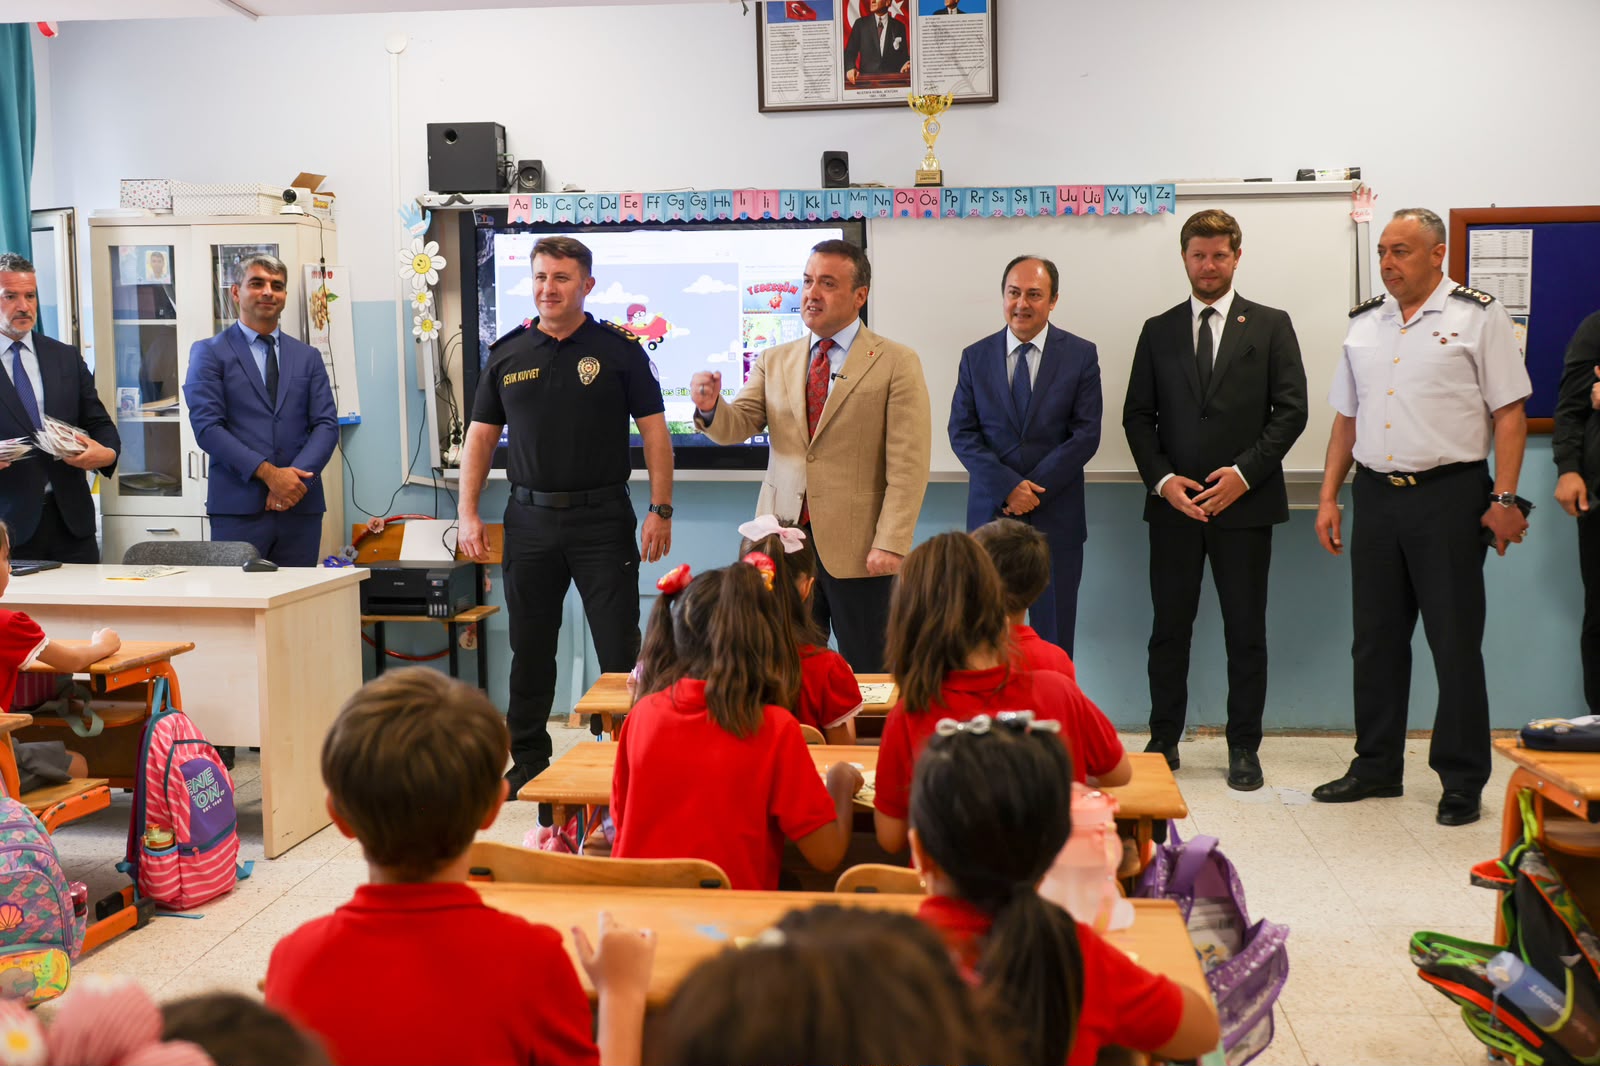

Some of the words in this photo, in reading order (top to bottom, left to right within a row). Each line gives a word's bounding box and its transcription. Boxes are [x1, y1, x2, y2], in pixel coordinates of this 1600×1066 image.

[513, 199, 528, 209] Aa
[535, 198, 548, 209] Bb
[556, 199, 571, 210] Cc
[578, 198, 594, 210] Çç
[601, 197, 616, 209] Dd
[625, 196, 638, 208] Ee
[647, 196, 660, 208] Ff
[667, 195, 684, 210] Gg
[714, 196, 730, 207] Hh
[785, 194, 795, 211] Jj
[806, 196, 819, 208] Kk
[831, 193, 841, 204] Ll
[850, 192, 867, 200] Mm
[874, 194, 890, 206] Nn
[896, 192, 914, 203] Oo
[920, 190, 937, 205] Öö
[945, 190, 958, 207] Pp
[971, 191, 984, 203] Rr
[992, 191, 1004, 202] Ss
[1015, 189, 1027, 204] Şş
[1040, 192, 1050, 203] Tt
[1060, 189, 1077, 202] Uu
[1083, 187, 1100, 203] Üü
[1108, 189, 1124, 201] Vv
[1132, 186, 1146, 204] Yy
[1156, 187, 1170, 199] Zz
[518, 368, 539, 380] KUVVET
